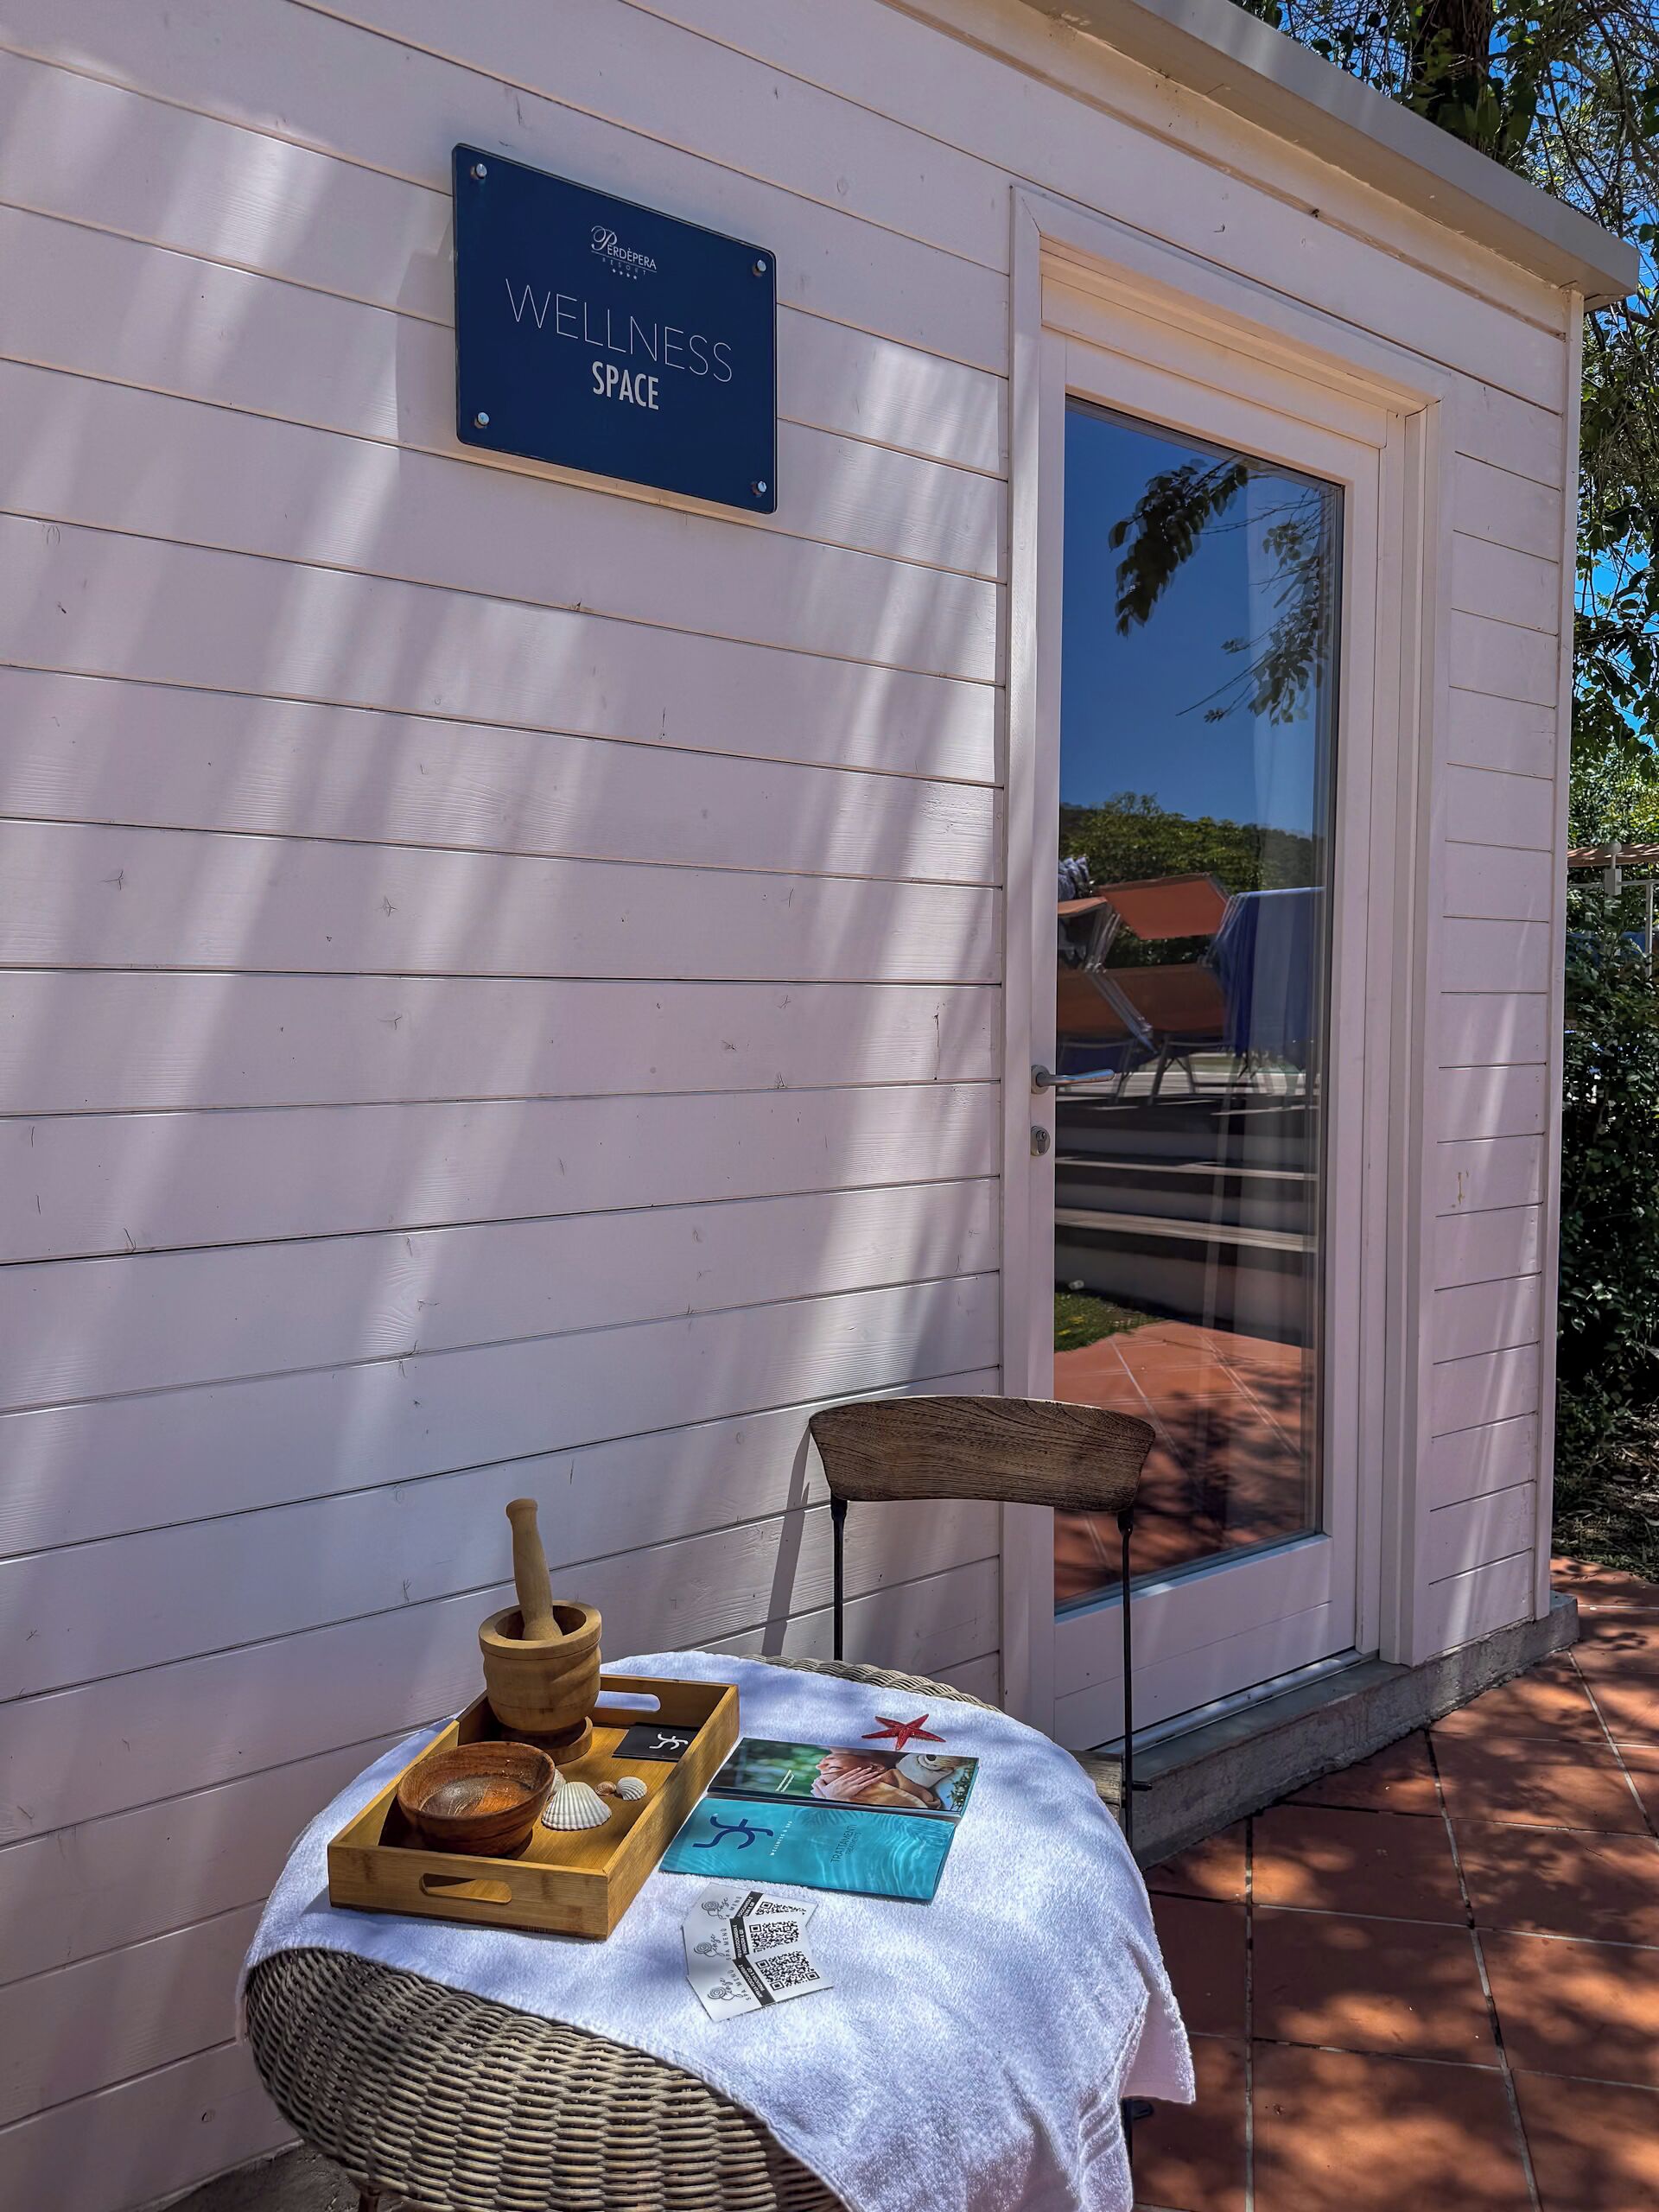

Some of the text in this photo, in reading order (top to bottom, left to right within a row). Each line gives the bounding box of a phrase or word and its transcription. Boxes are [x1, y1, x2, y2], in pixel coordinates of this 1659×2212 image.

[591, 226, 657, 270] PERDÈPERA
[505, 278, 733, 382] WELLNESS
[592, 360, 659, 410] SPACE
[830, 1824, 856, 1862] TRATTAMENTI
